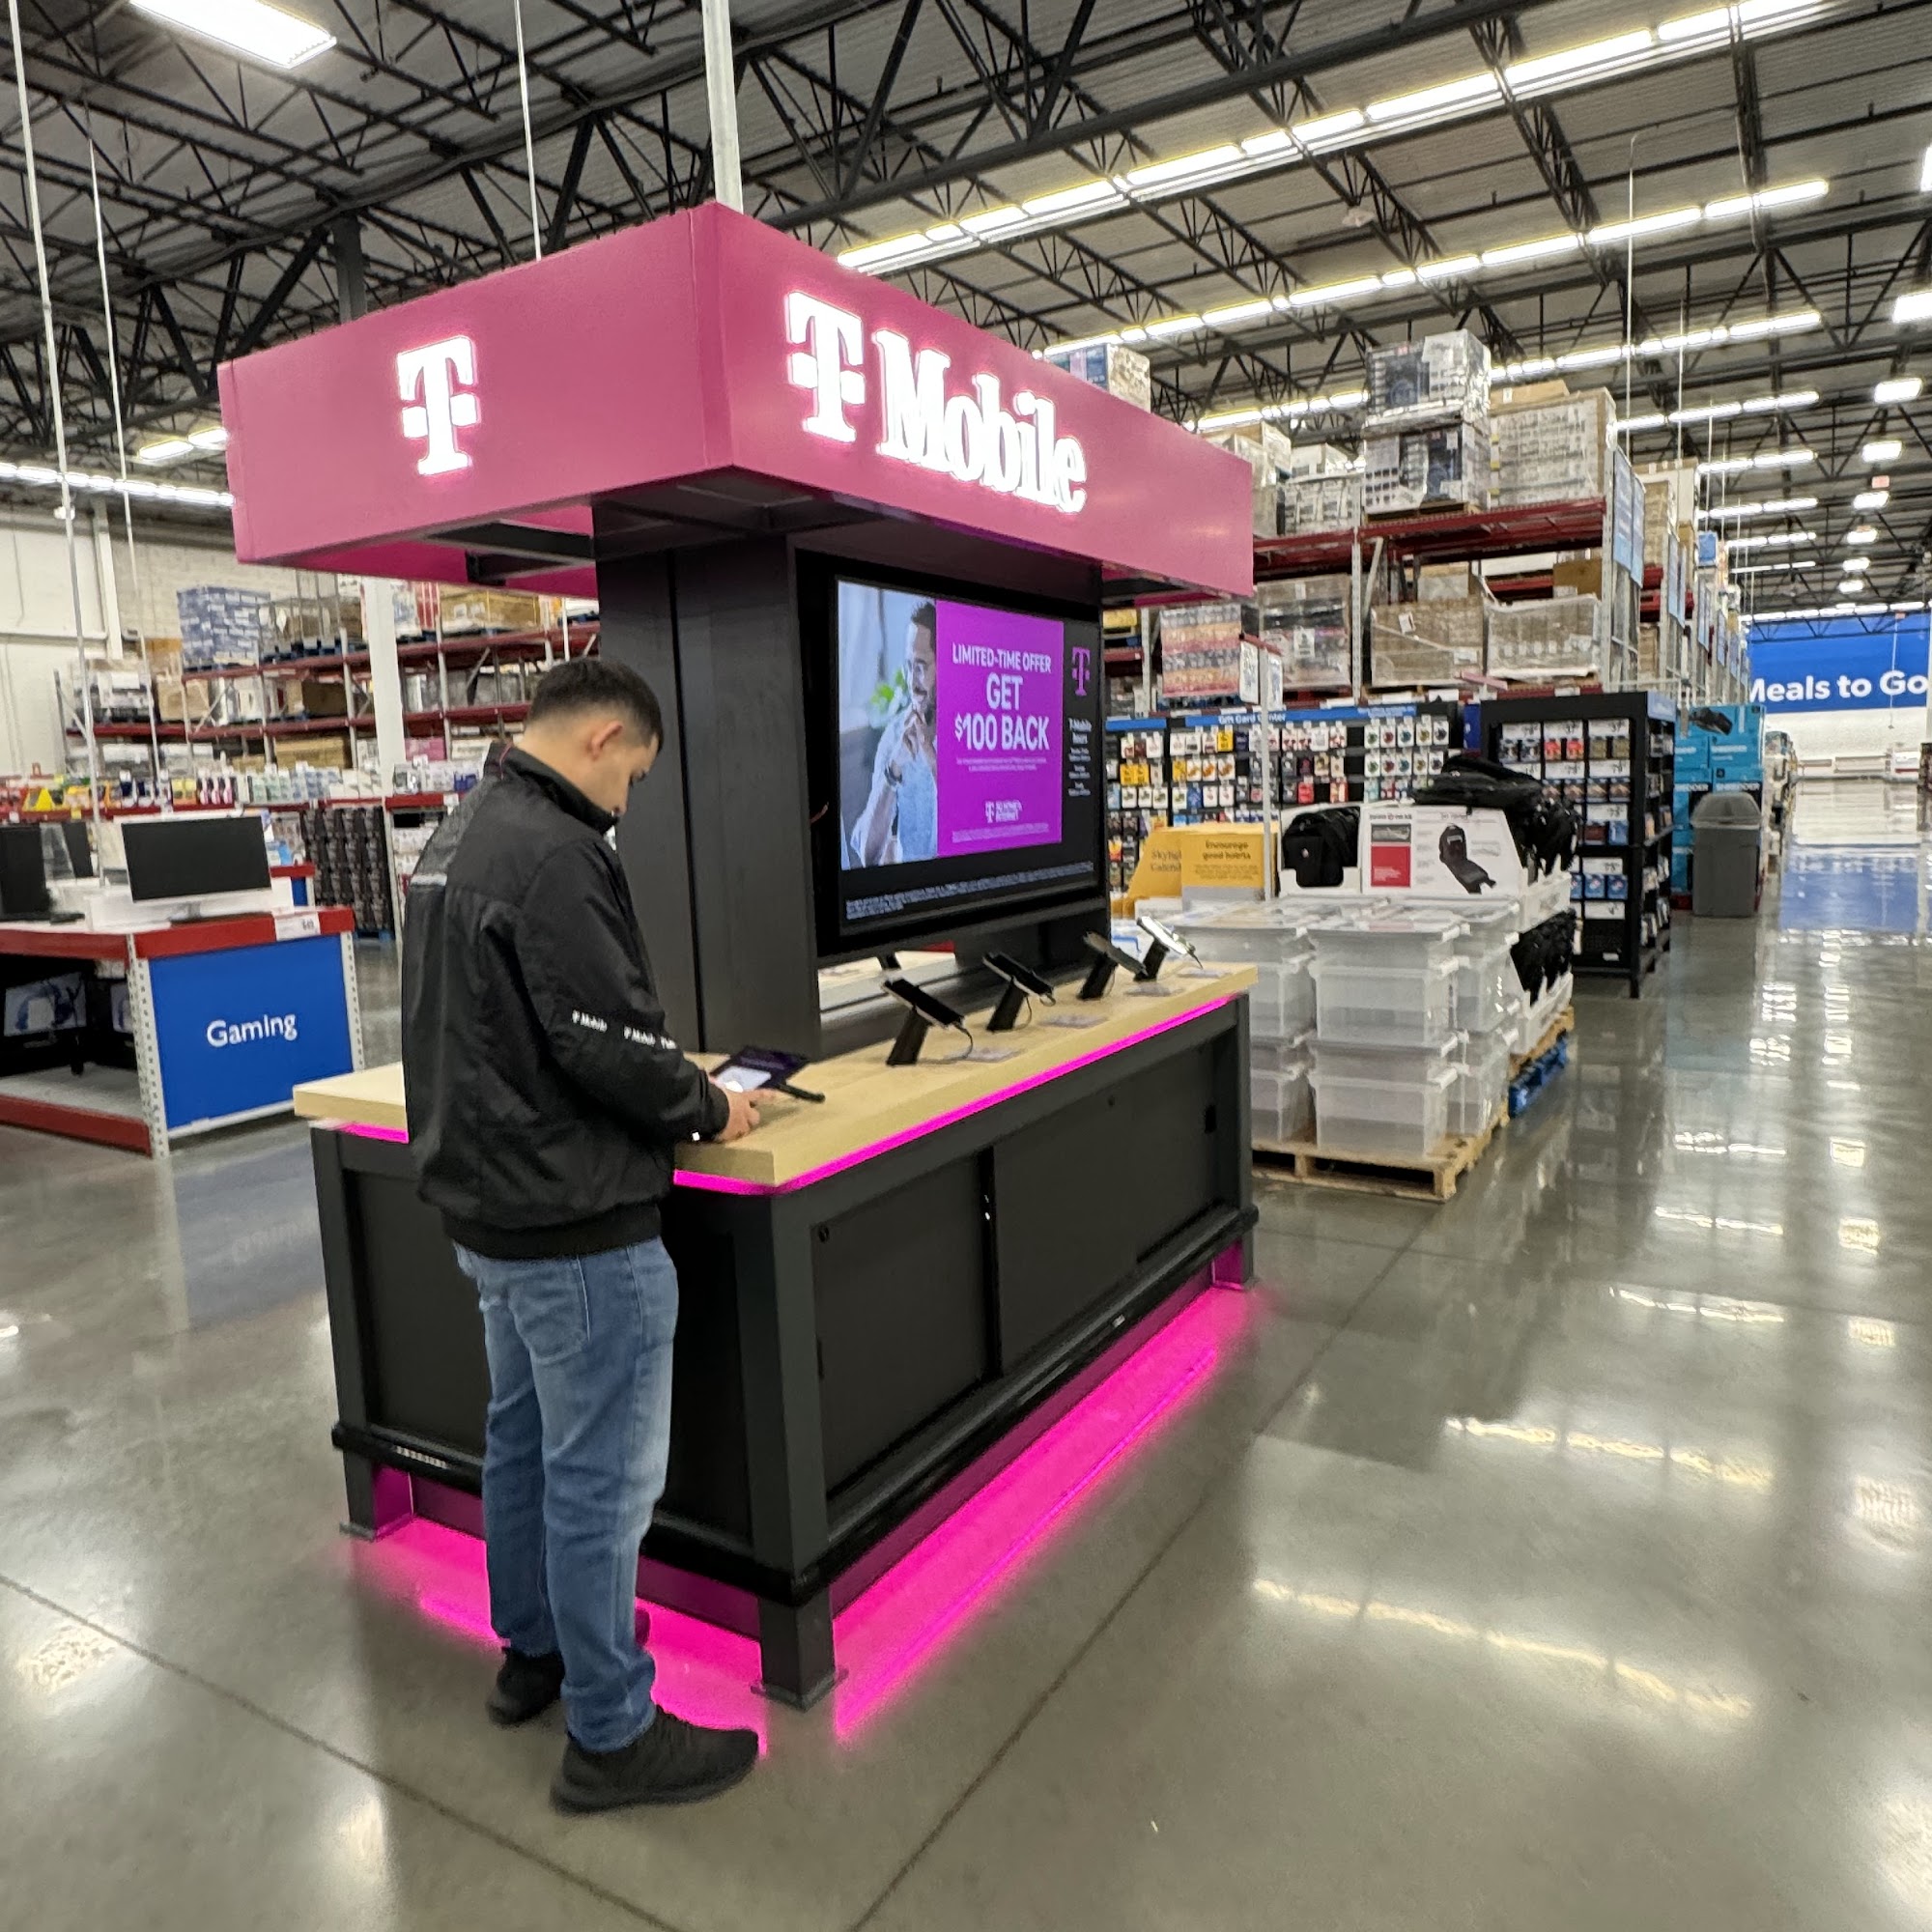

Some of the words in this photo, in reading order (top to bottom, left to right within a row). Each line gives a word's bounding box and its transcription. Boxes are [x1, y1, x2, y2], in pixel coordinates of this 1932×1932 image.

[397, 334, 481, 476] T
[873, 328, 1087, 513] Mobile
[952, 641, 1021, 671] LIMITED-TIME
[1022, 650, 1052, 673] OFFER
[986, 671, 1024, 711] GET
[1749, 674, 1831, 703] Meals
[1836, 673, 1872, 698] to
[1879, 669, 1928, 696] Go
[954, 712, 998, 752] $100
[1001, 714, 1051, 751] BACK
[207, 1014, 298, 1048] Gaming
